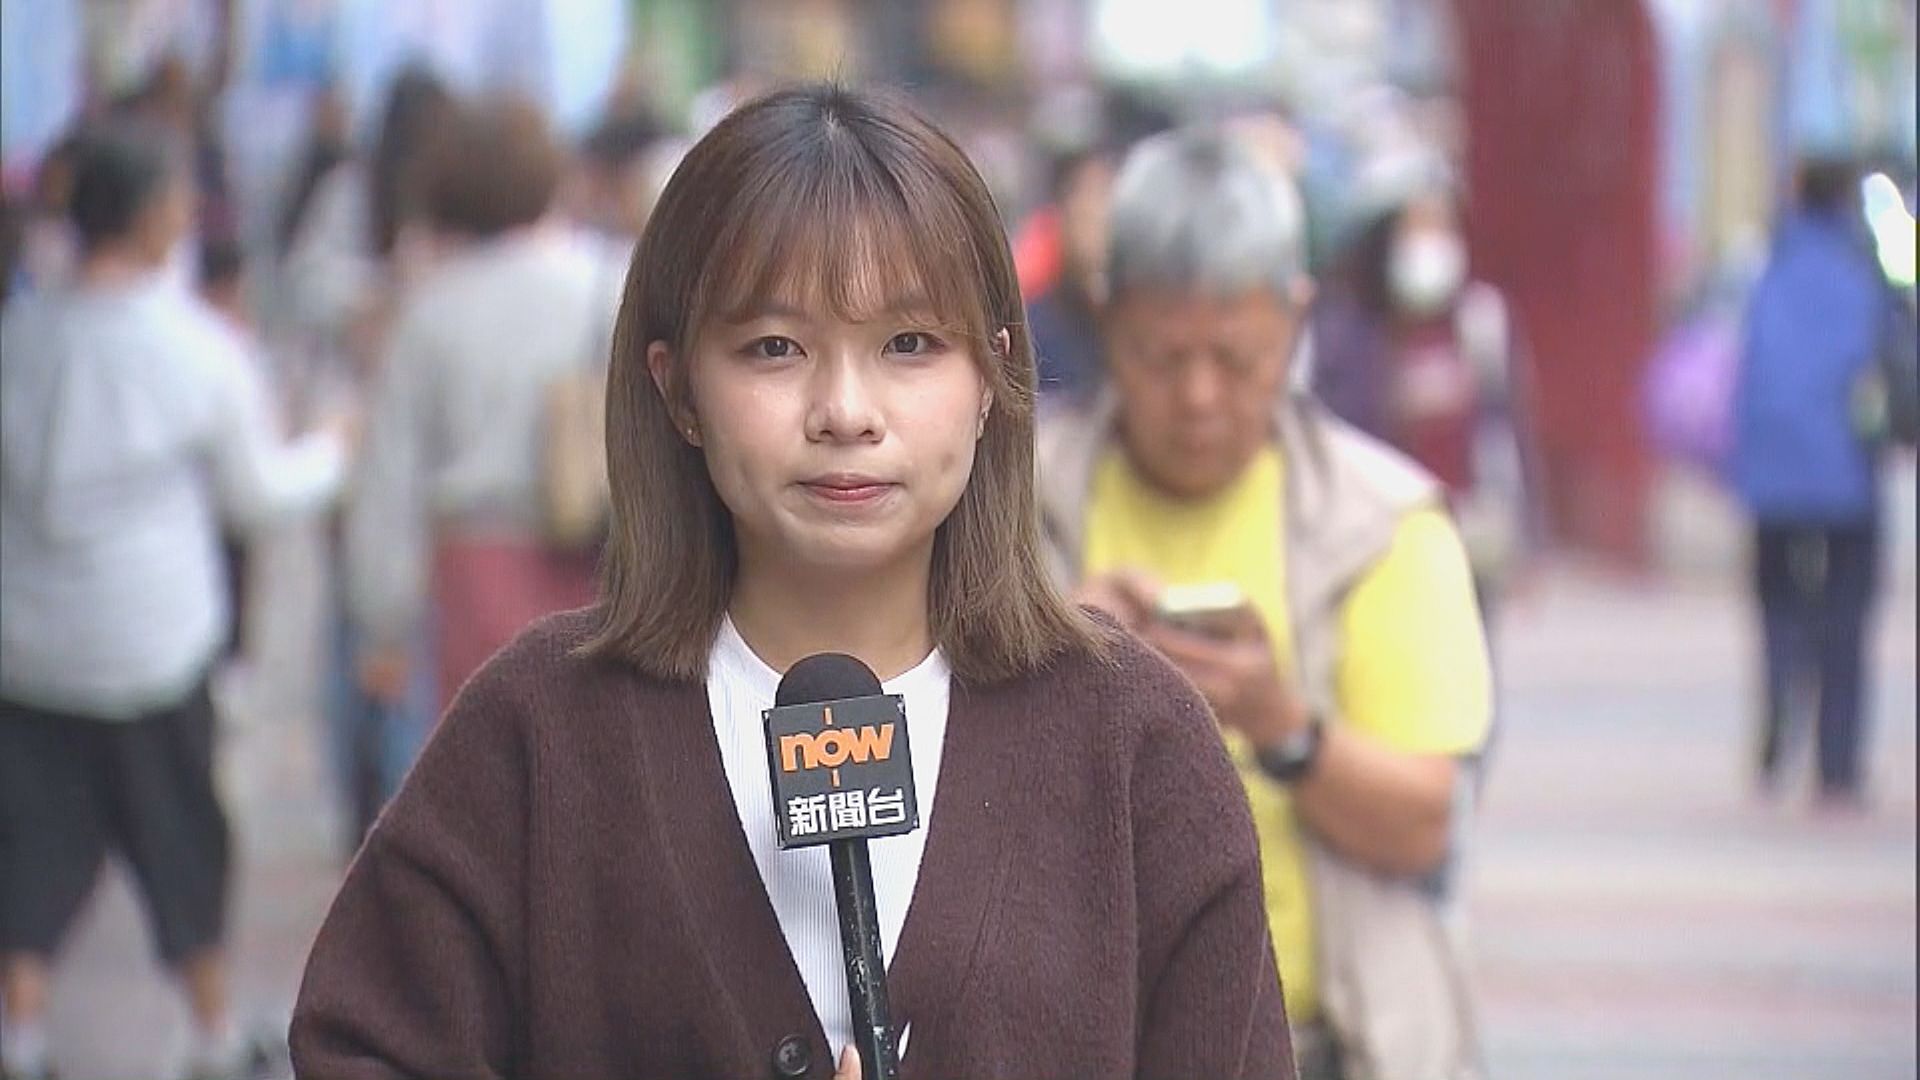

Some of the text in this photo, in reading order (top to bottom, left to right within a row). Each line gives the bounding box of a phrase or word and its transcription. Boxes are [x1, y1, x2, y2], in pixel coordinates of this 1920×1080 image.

[779, 723, 895, 772] now
[787, 786, 906, 836] 新聞台
